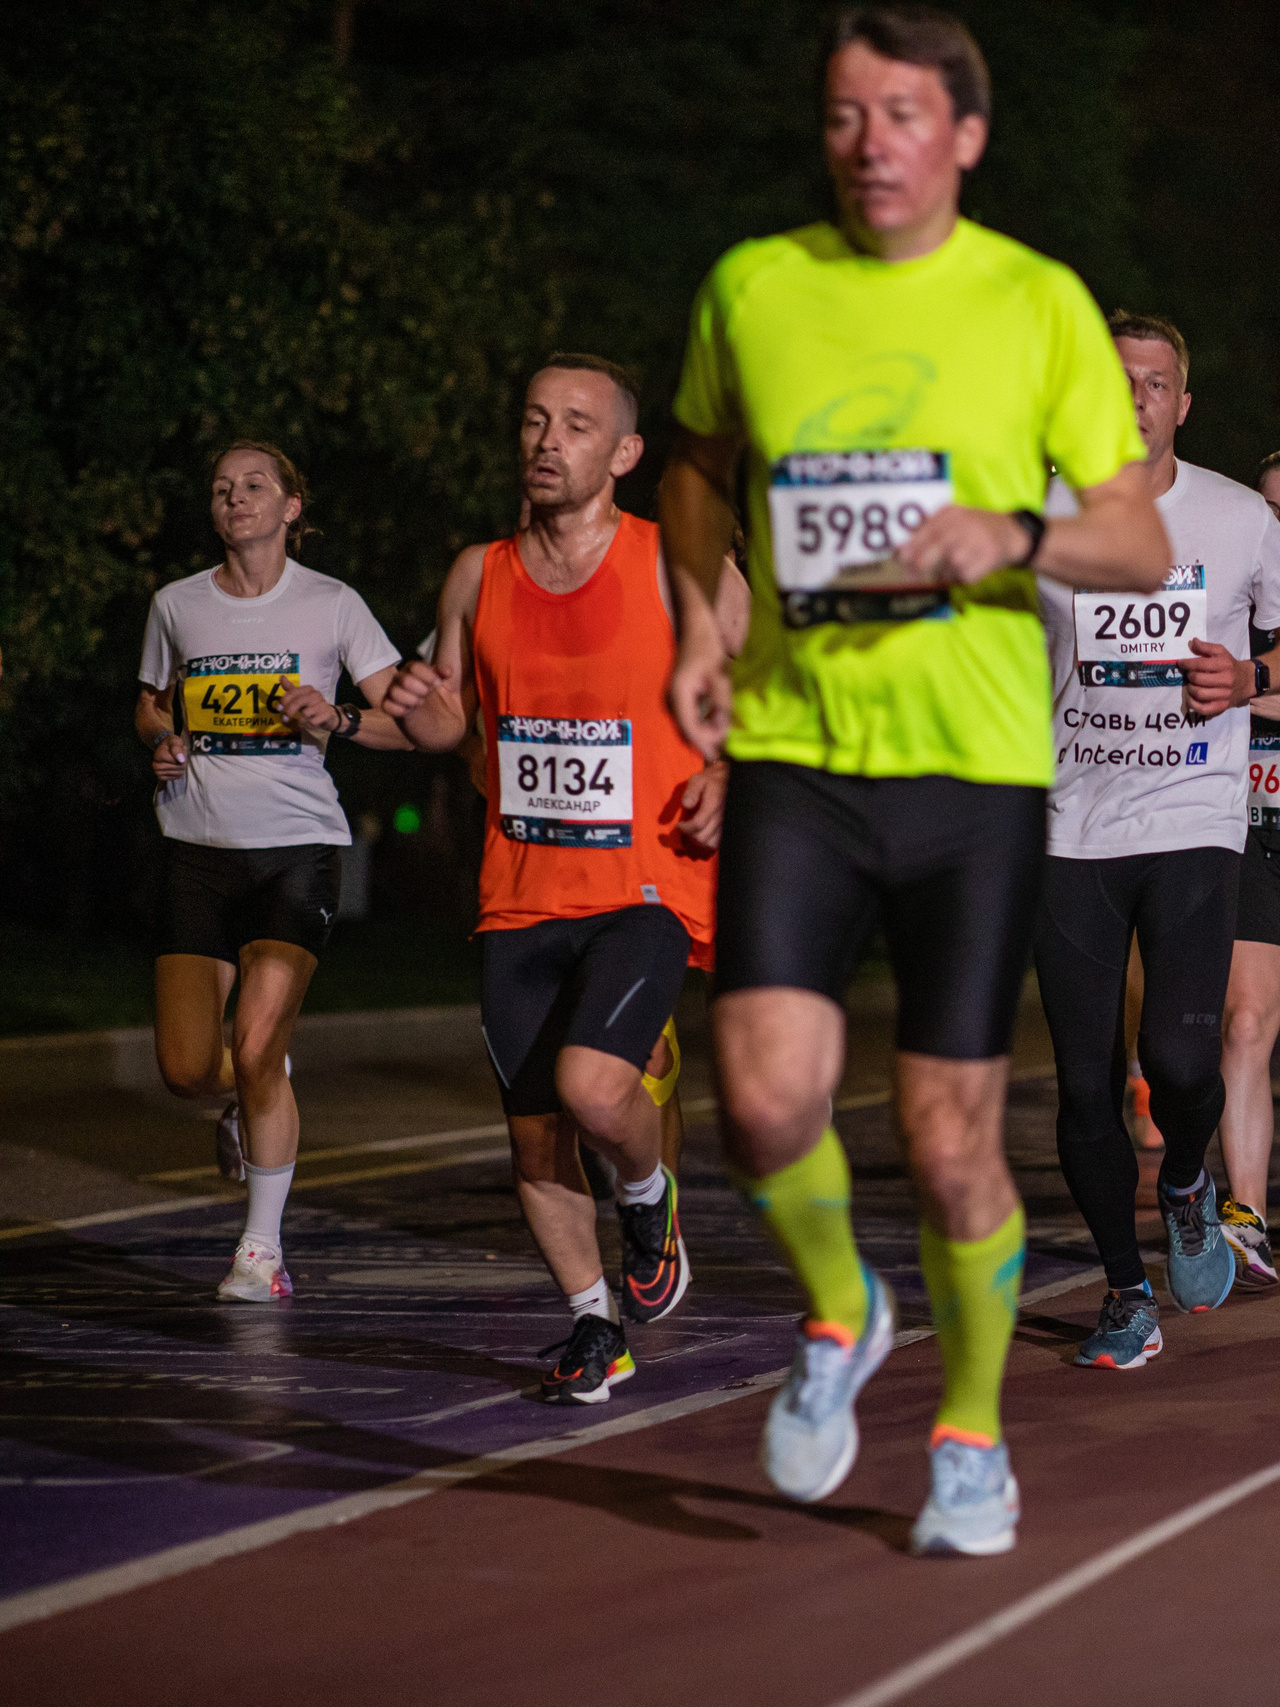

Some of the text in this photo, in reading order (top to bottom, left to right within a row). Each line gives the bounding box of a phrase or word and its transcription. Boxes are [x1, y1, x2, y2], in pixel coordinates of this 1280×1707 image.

[1094, 601, 1191, 640] 2609
[1120, 642, 1165, 654] DMITRY
[201, 683, 282, 715] 4216
[213, 717, 275, 728] ЕКАТЕРИНА
[1063, 708, 1136, 731] Ставь
[1074, 742, 1182, 767] Interlab
[517, 753, 615, 796] 8134
[527, 797, 601, 813] АЛЕКСАНДР
